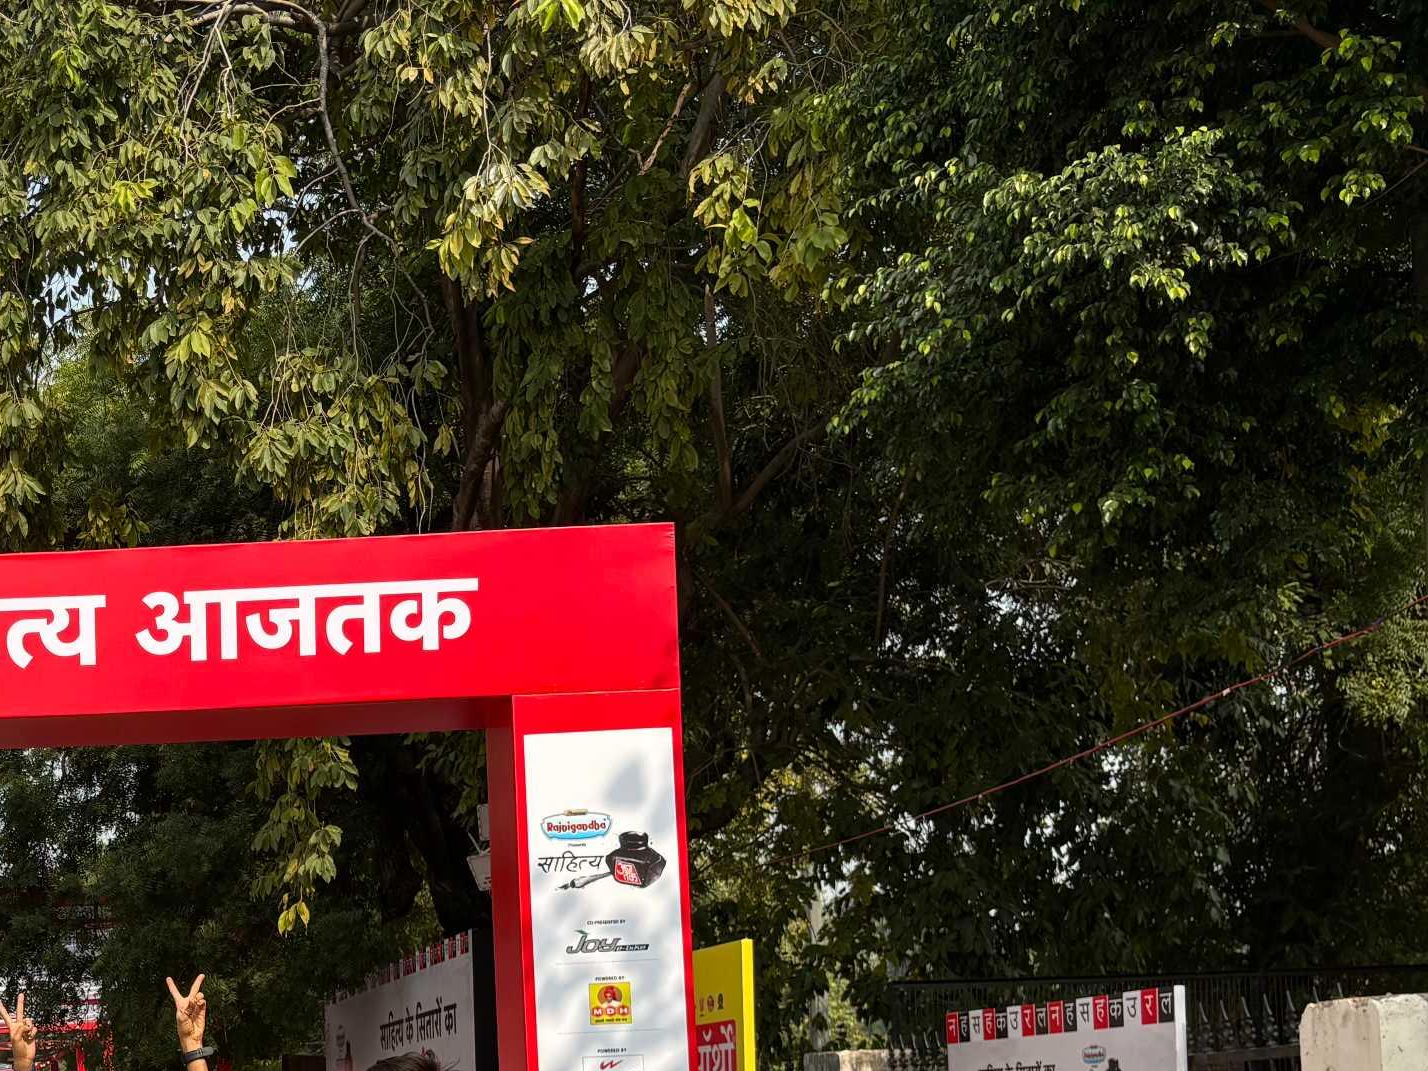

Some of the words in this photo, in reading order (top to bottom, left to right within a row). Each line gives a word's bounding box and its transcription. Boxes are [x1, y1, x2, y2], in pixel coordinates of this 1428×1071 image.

[135, 577, 479, 662] आजतक
[547, 820, 606, 833] Rajnigandha
[537, 850, 604, 873] साहित्य
[380, 1010, 404, 1051] साहित्य
[405, 1007, 414, 1044] के
[444, 1003, 457, 1036] का
